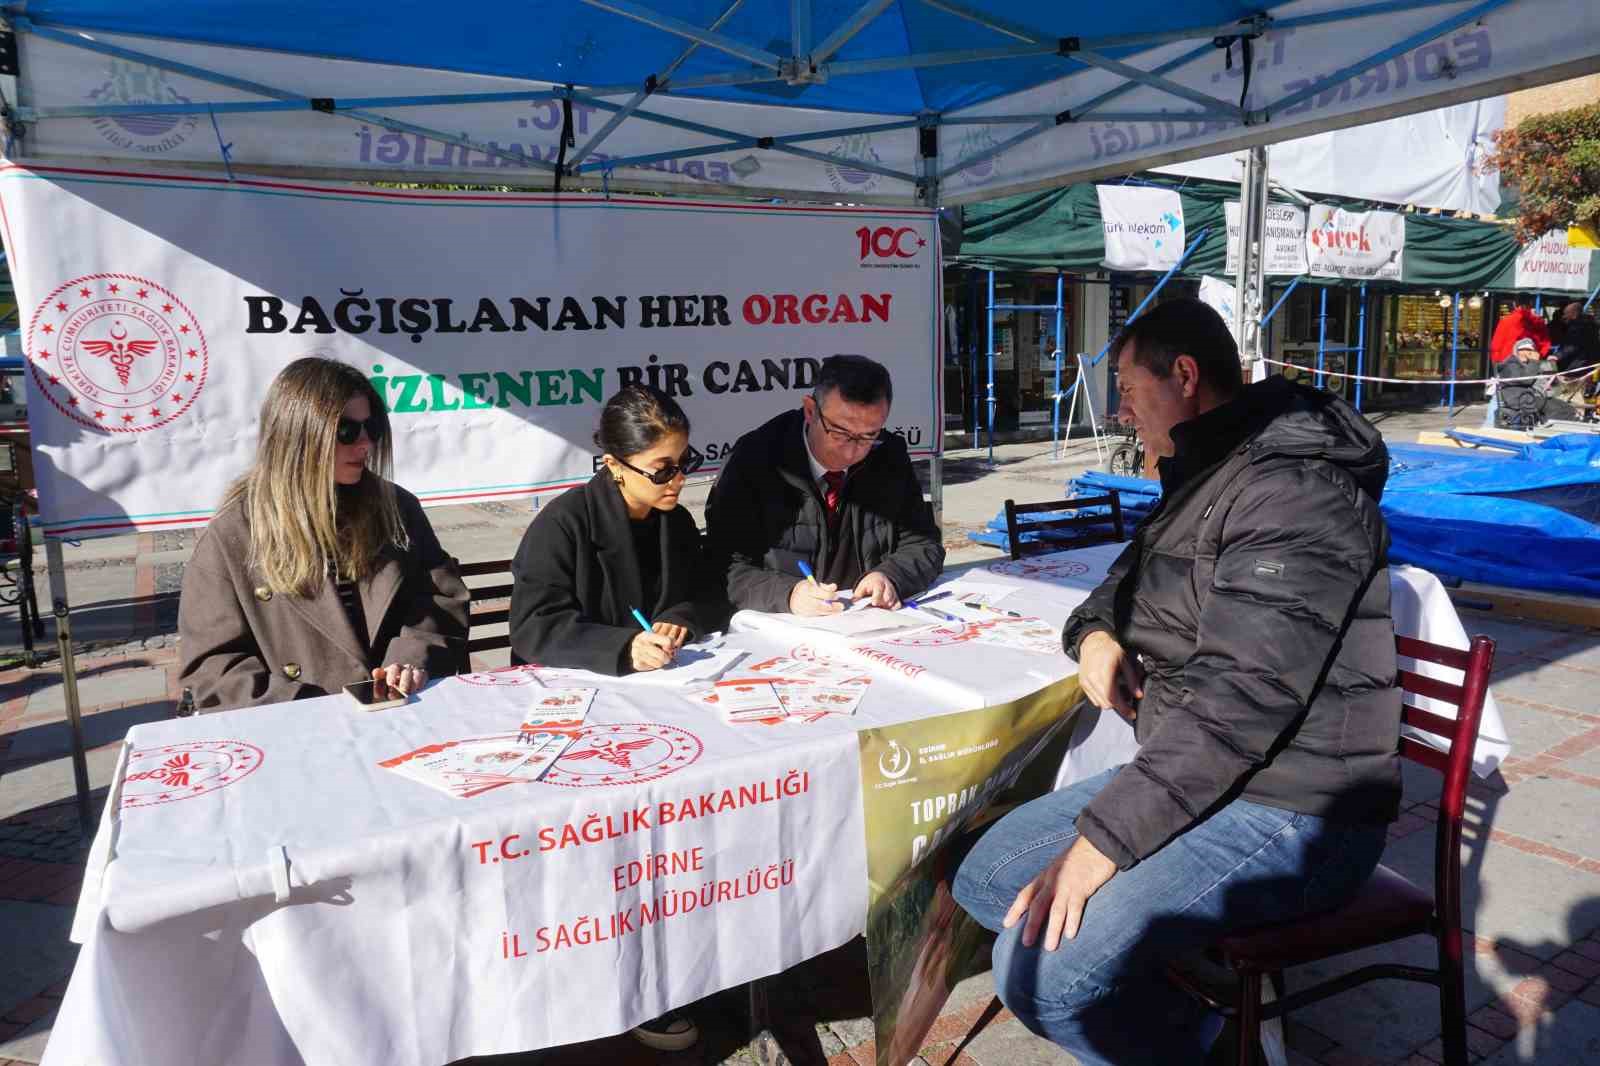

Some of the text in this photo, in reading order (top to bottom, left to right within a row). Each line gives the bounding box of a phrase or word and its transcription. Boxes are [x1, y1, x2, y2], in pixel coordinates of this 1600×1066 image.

[243, 288, 893, 343] BAĞIŞLANAN HER ORGAN
[702, 356, 828, 394] CAND
[472, 769, 810, 865] T.C. SAĞLIK BAKANLIĞI
[613, 846, 705, 892] EDİRNE
[502, 857, 796, 959] İL SAĞLIK MÜDÜRLÜĞÜ
